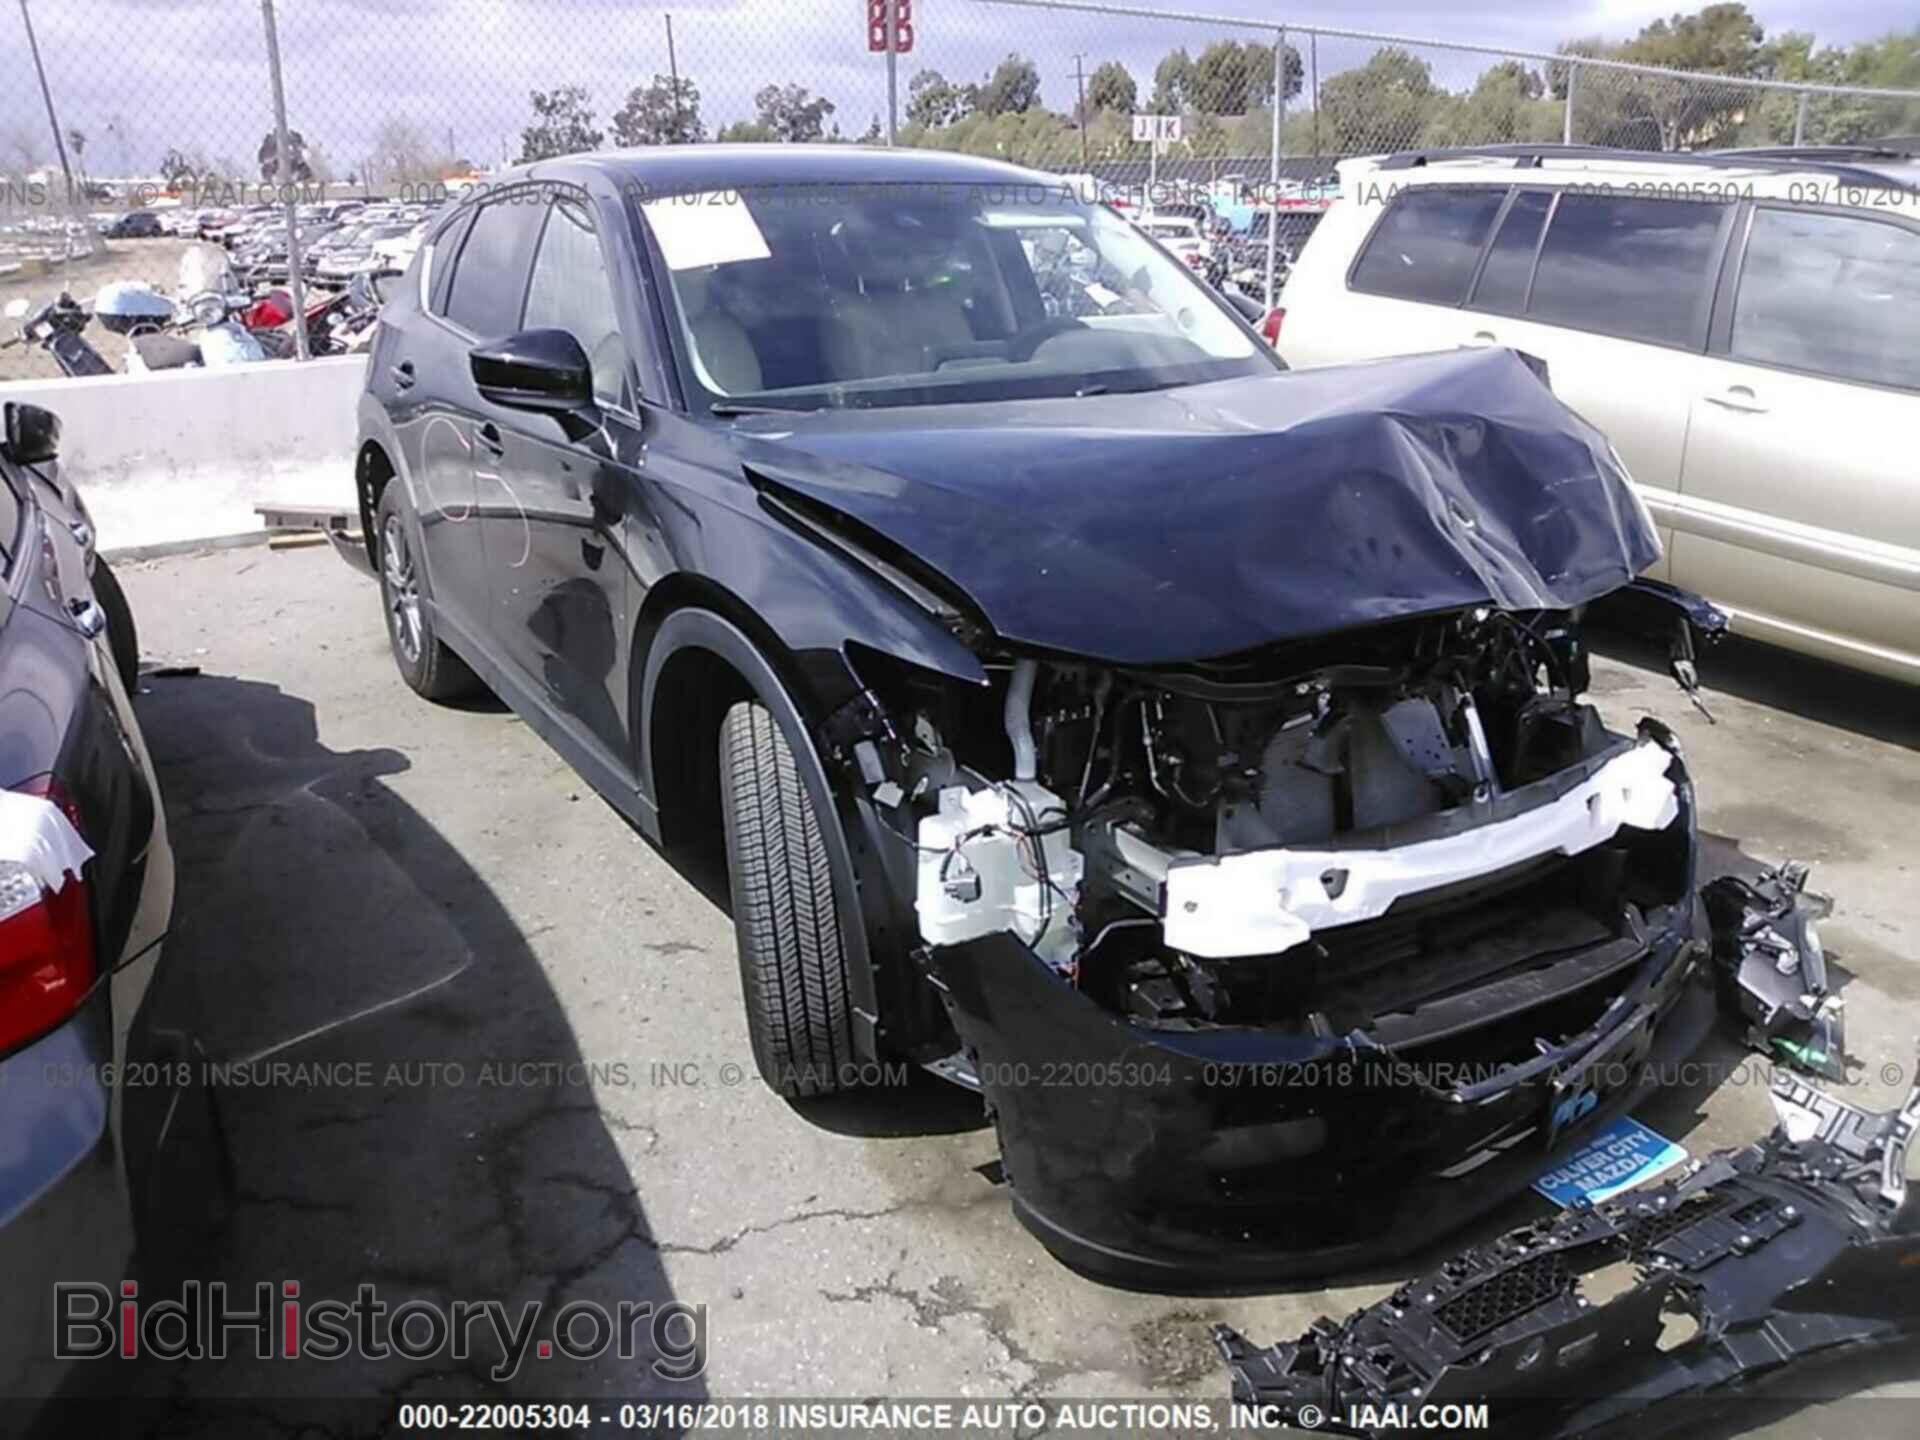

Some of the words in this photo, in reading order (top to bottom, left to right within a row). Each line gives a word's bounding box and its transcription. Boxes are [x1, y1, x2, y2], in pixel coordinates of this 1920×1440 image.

[1538, 1152, 1614, 1189] CULVER
[1607, 1130, 1651, 1157] CITY
[1575, 1152, 1650, 1191] MAZDA
